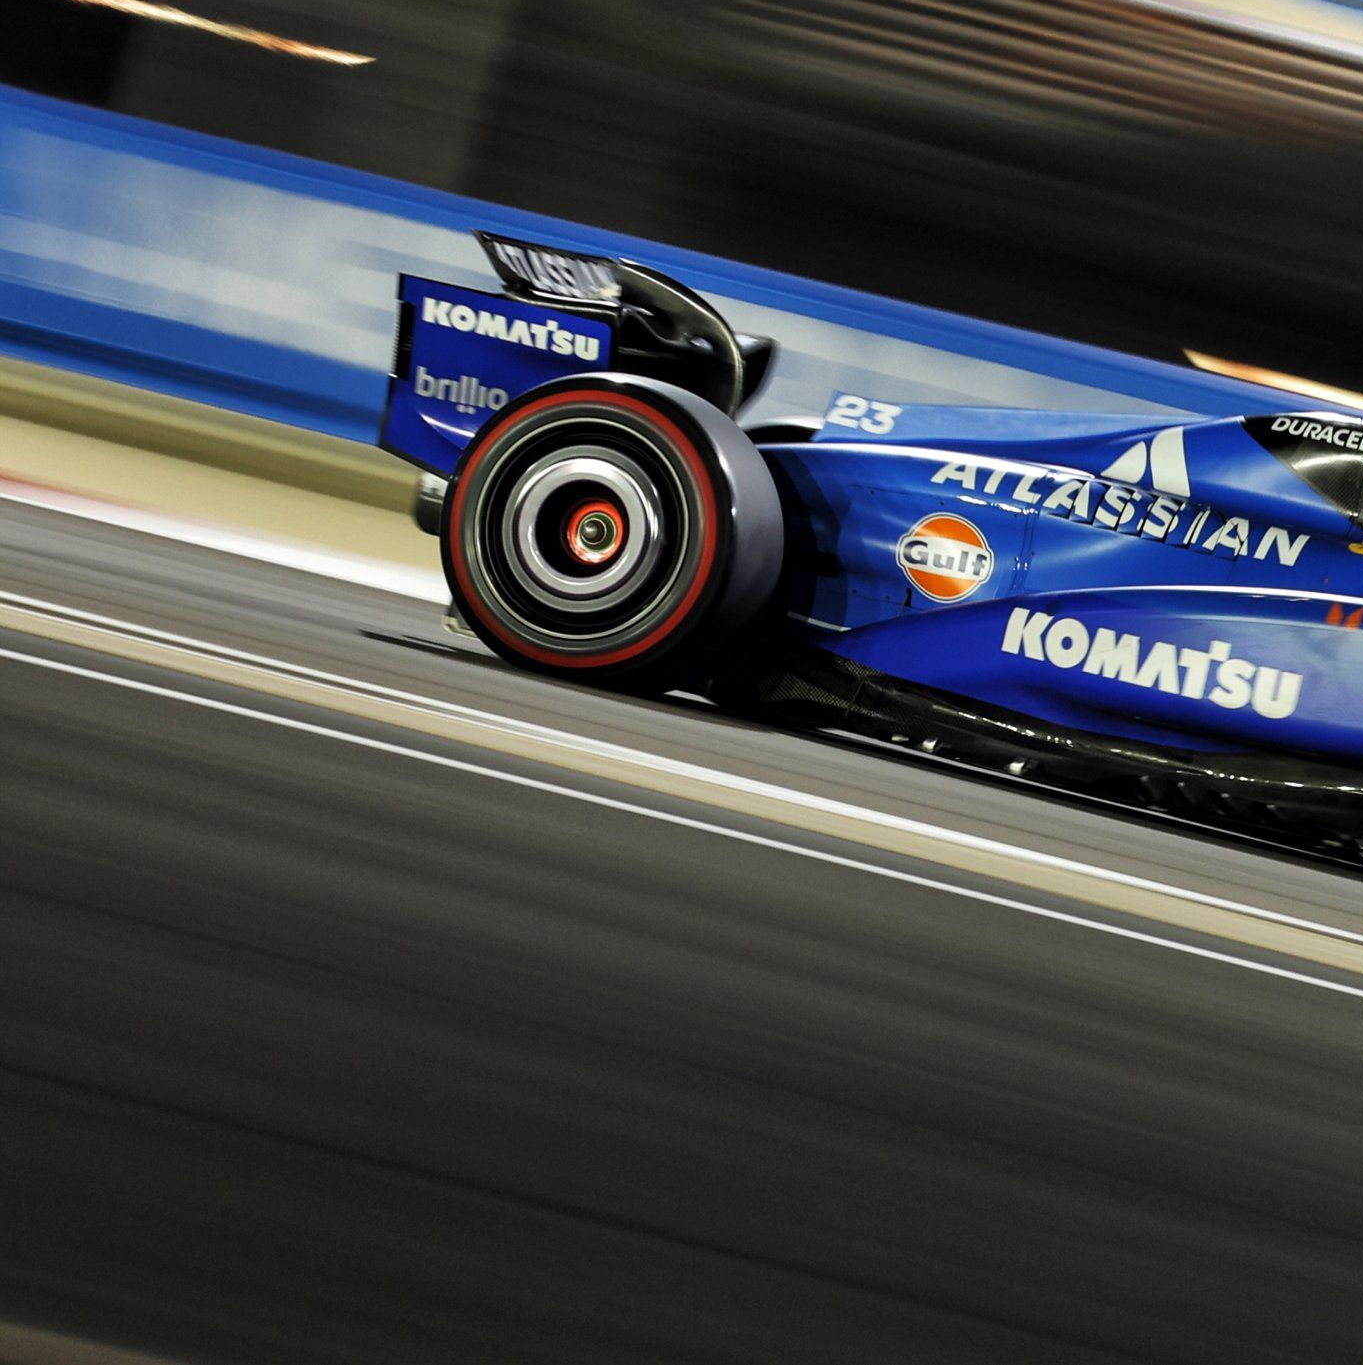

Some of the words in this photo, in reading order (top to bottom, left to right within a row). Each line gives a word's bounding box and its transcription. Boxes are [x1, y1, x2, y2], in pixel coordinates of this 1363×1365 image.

[422, 296, 600, 361] KOMATSU
[826, 394, 903, 435] 23
[903, 540, 987, 576] Gulf
[1001, 606, 1303, 720] KOMATSU
